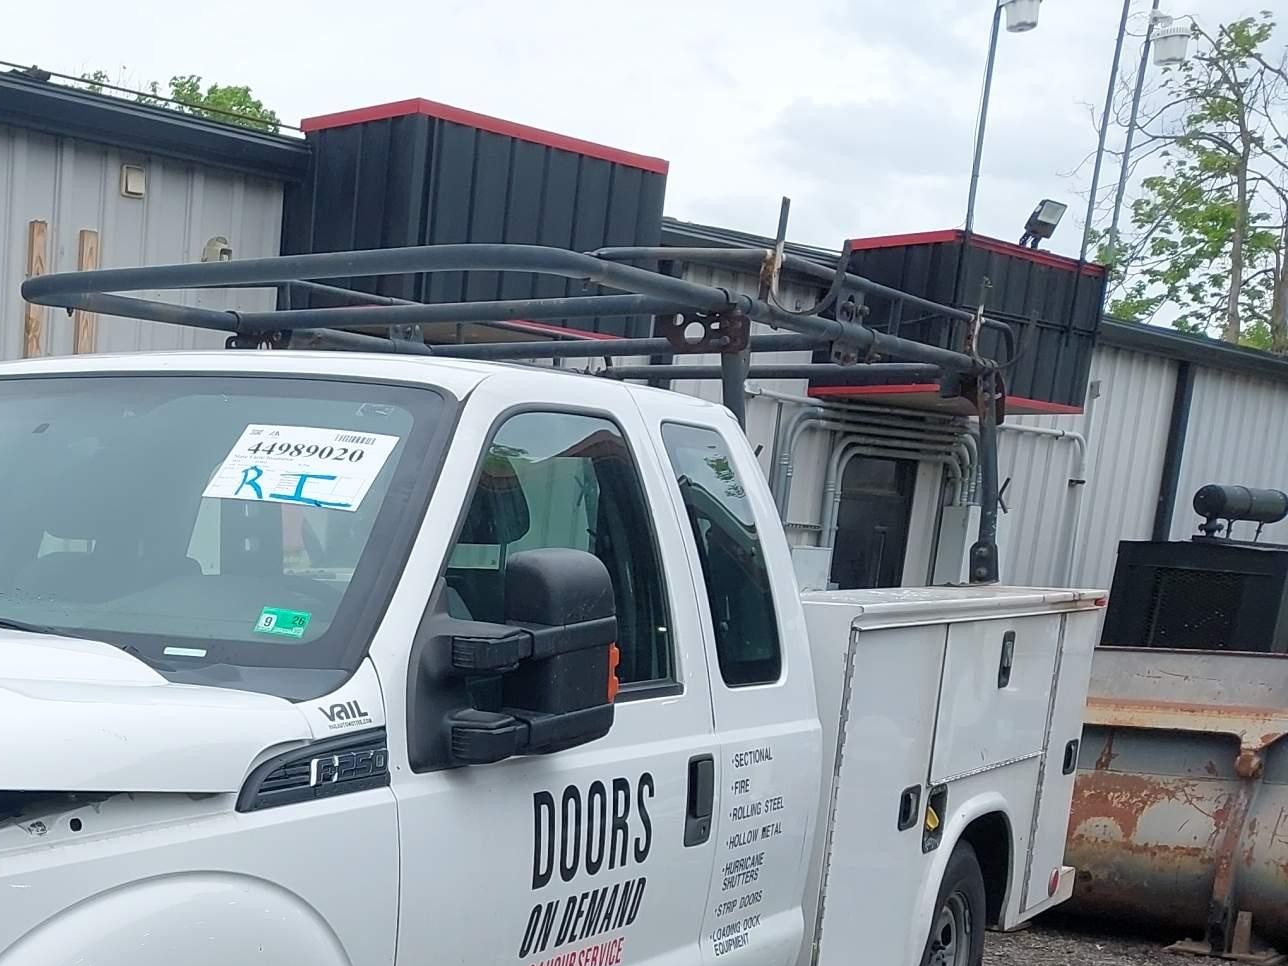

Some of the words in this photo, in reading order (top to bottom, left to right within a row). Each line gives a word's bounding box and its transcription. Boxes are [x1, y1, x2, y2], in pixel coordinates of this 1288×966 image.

[247, 441, 365, 463] 44989020
[234, 465, 263, 499] R
[263, 616, 273, 627] 9
[292, 615, 305, 626] 26
[318, 700, 368, 721] VAIL
[735, 747, 773, 768] SECTIONAL
[734, 778, 750, 795] FIRE
[732, 801, 762, 821] ROLLING
[764, 796, 784, 814] STEEL
[531, 772, 655, 890] DOORS
[728, 828, 759, 849] HOLLOW
[761, 822, 782, 840] METAL
[724, 852, 765, 876] HURRICANE
[722, 867, 759, 891] SHUTTERS
[716, 899, 738, 917] STRIP
[739, 890, 763, 909] DOORS
[518, 899, 560, 959] ON
[554, 877, 647, 948] DEMAND
[712, 920, 741, 942] LOADING
[743, 913, 761, 931] DOCK
[713, 932, 749, 957] EQUIPMENT
